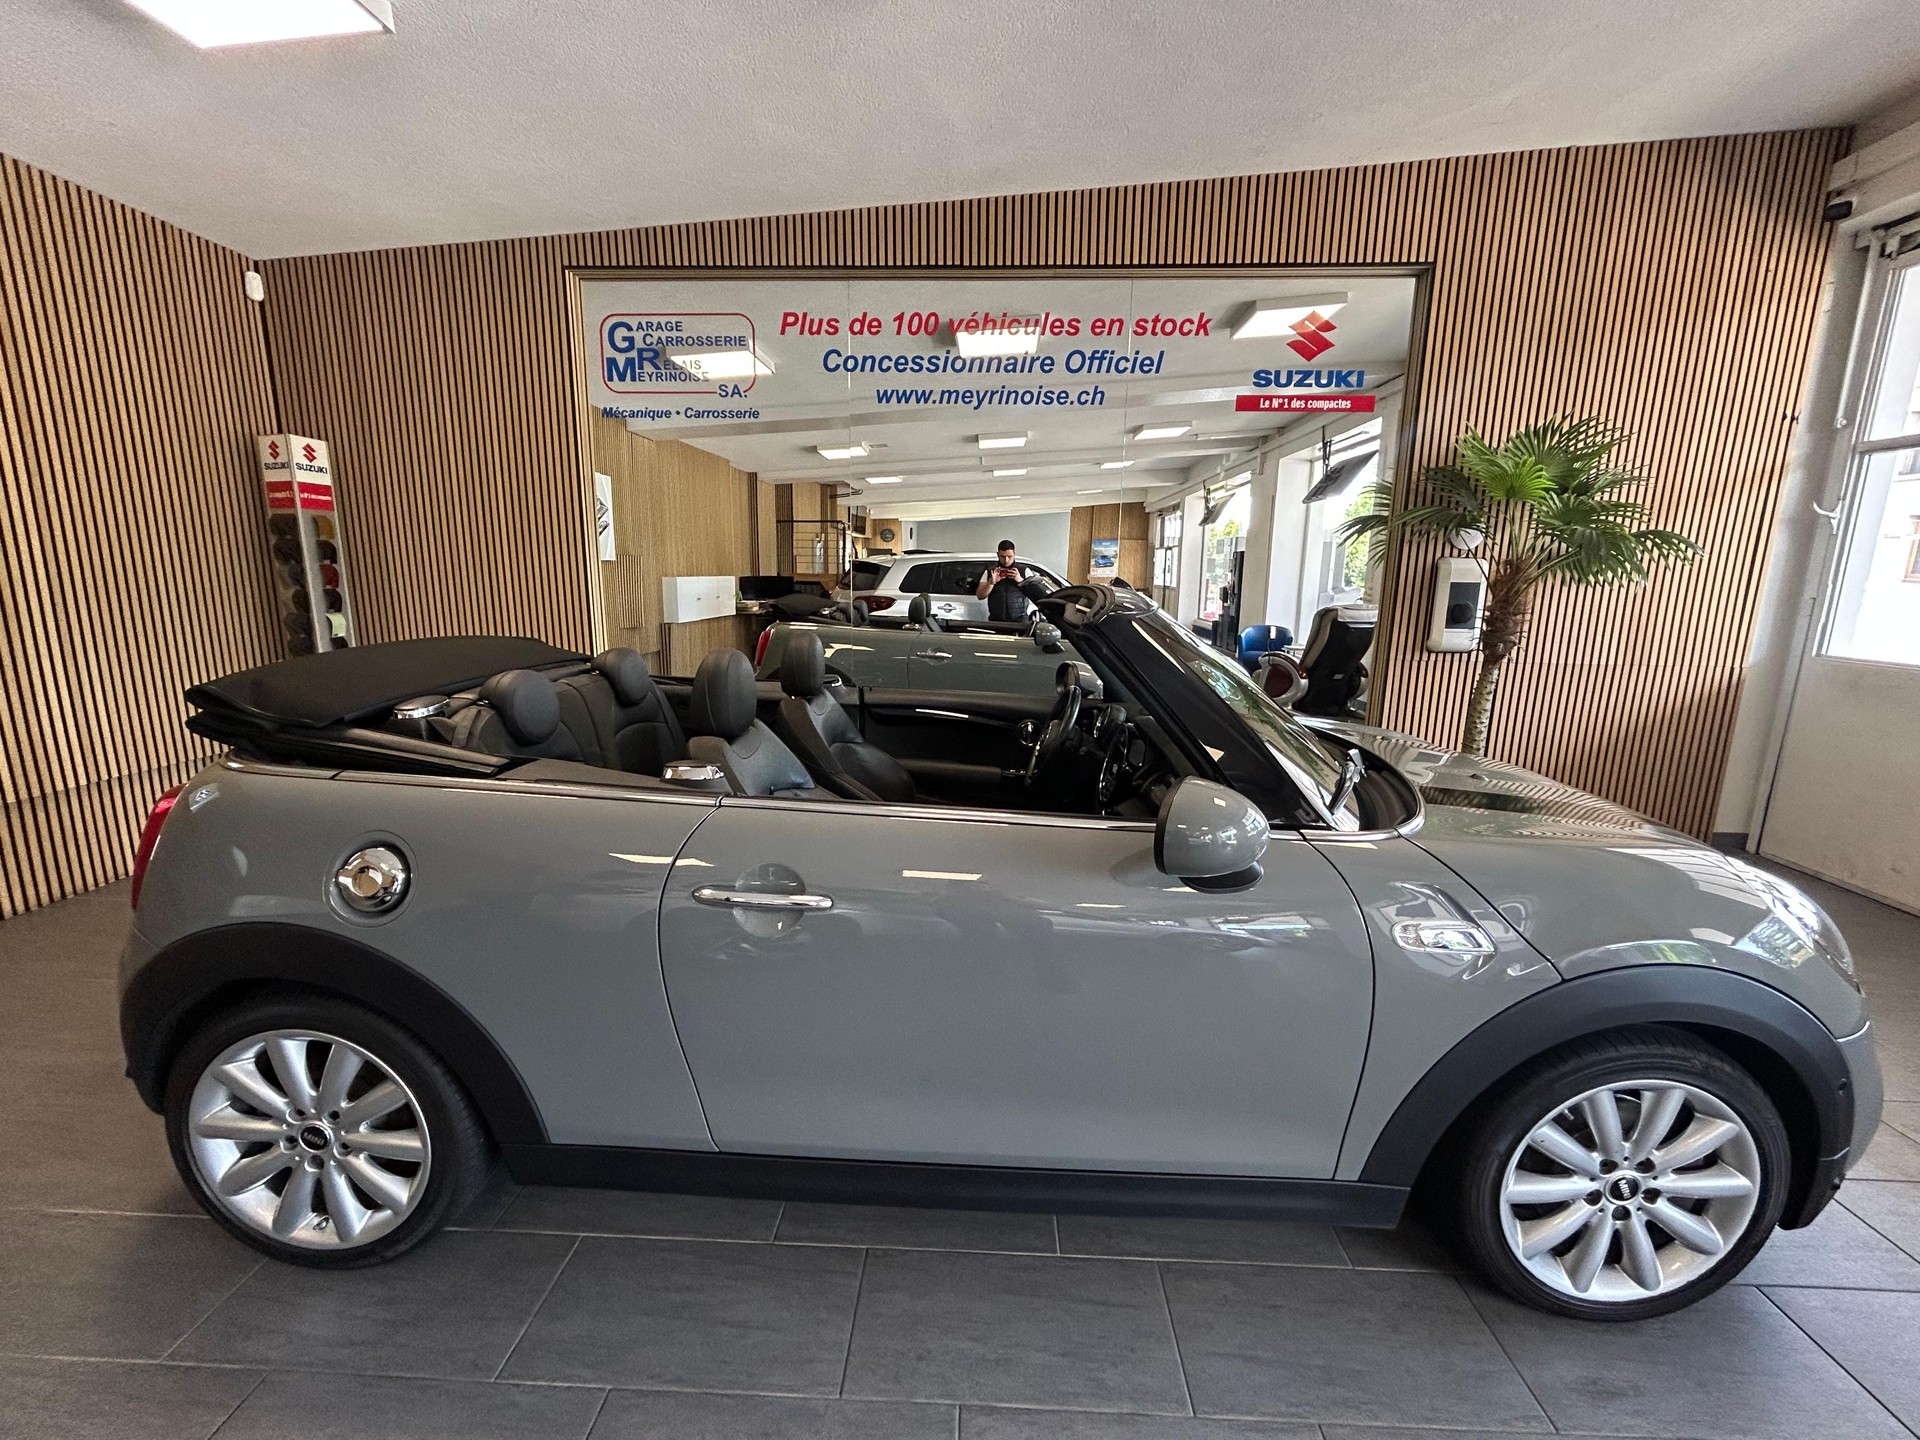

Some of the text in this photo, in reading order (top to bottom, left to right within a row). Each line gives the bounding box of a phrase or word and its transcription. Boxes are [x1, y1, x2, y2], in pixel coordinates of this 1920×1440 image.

[779, 311, 1211, 337] Plus de 100 véhicules en stock
[607, 320, 683, 354] GARAGE
[642, 333, 747, 347] CARROSSERIE
[821, 348, 1165, 374] Concessionnaire Officiel
[1252, 369, 1365, 389] SUZUKI
[717, 383, 749, 399] SA.
[875, 384, 1106, 410] www.meyrinoise.ch
[1259, 397, 1270, 409] Le
[1290, 397, 1306, 409] des
[1307, 398, 1352, 411] compactes
[601, 405, 760, 420] Mécanique Carrosserie
[264, 462, 289, 470] SUZUKI
[295, 463, 328, 474] SUZUKI
